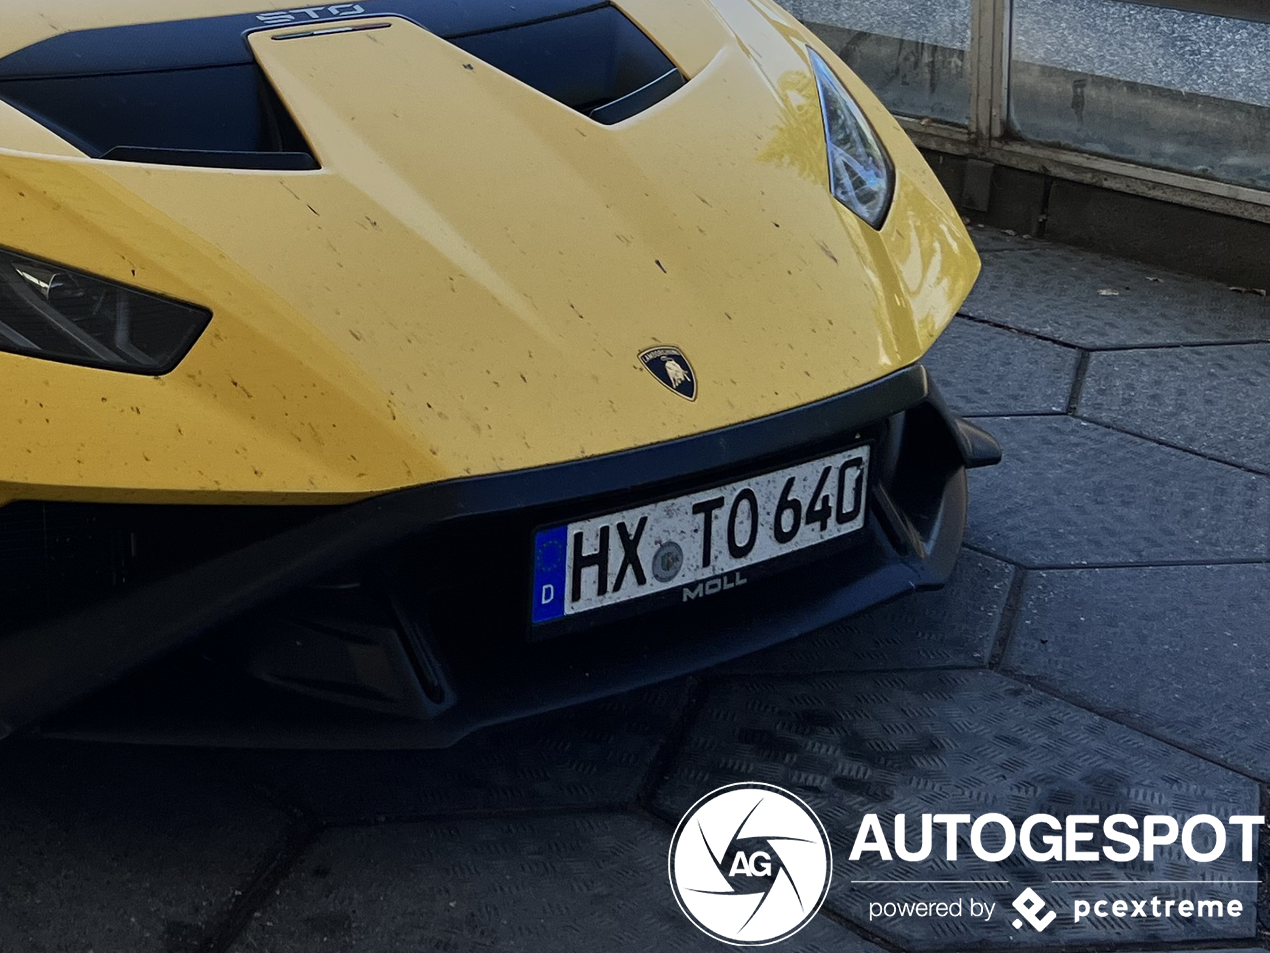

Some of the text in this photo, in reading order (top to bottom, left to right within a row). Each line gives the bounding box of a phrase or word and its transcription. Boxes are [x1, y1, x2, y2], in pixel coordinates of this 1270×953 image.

[256, 4, 365, 24] STO
[571, 456, 863, 602] HX TO 640
[541, 583, 554, 605] D
[682, 572, 748, 602] MOLL
